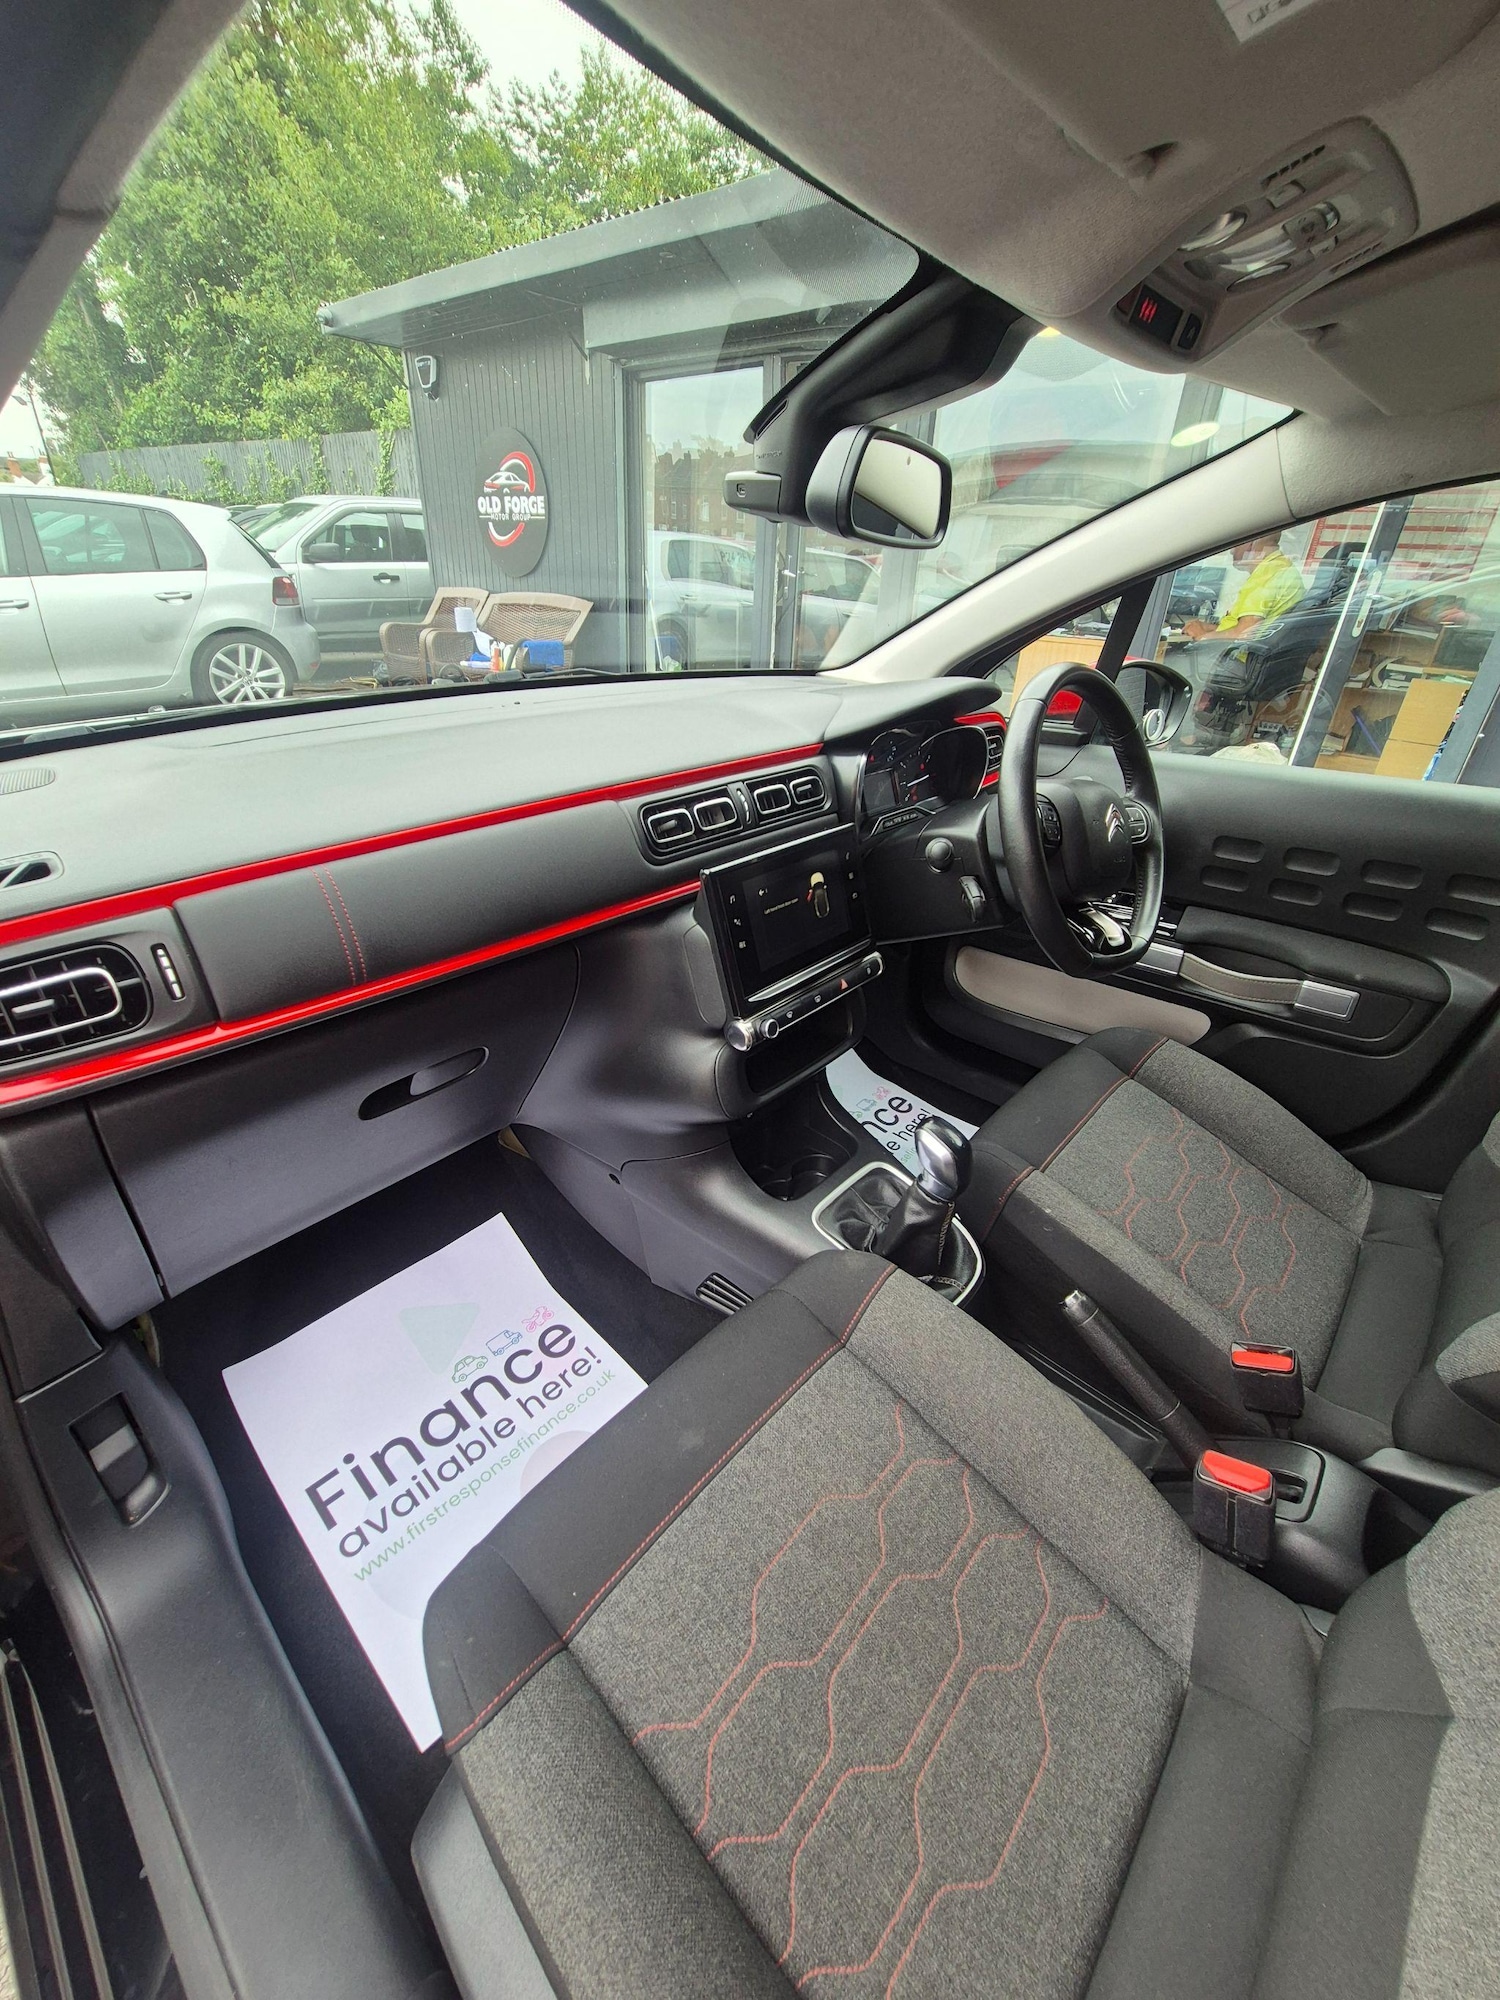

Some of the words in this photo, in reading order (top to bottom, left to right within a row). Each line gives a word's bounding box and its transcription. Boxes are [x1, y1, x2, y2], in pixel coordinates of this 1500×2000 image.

[477, 495, 502, 514] OLD
[503, 495, 545, 515] FORGE
[491, 513, 510, 521] MOTOR
[512, 513, 531, 521] GROUP
[304, 1323, 577, 1532] Finance
[338, 1416, 517, 1559] available
[515, 1345, 603, 1420] here!
[353, 1368, 617, 1583] www.firstresponsefinance.co.uk
